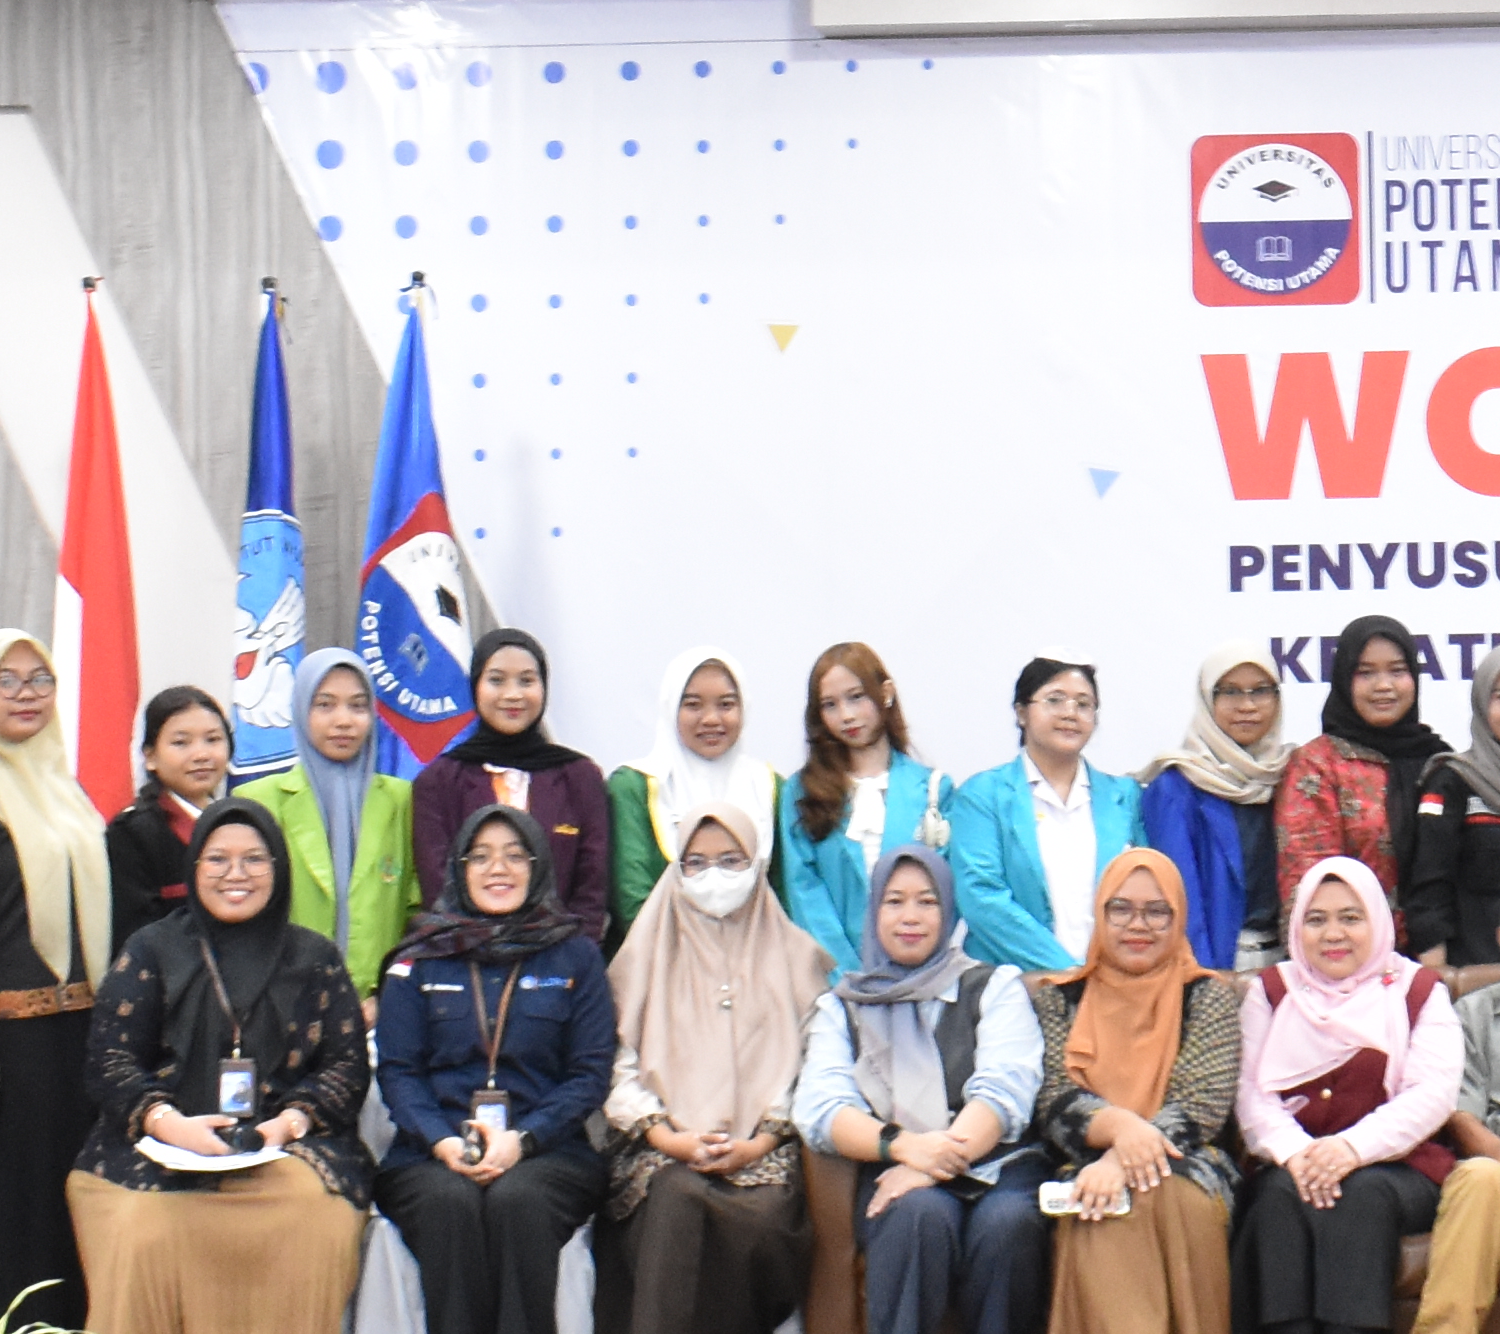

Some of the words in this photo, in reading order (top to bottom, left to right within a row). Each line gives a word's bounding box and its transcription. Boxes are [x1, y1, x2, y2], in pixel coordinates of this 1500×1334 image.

[1216, 149, 1335, 189] UNIVERSITAS
[1213, 249, 1284, 291] POTENSI
[1285, 247, 1341, 289] UTAMA
[361, 599, 399, 693] POTENSI
[398, 687, 458, 714] UTAMA
